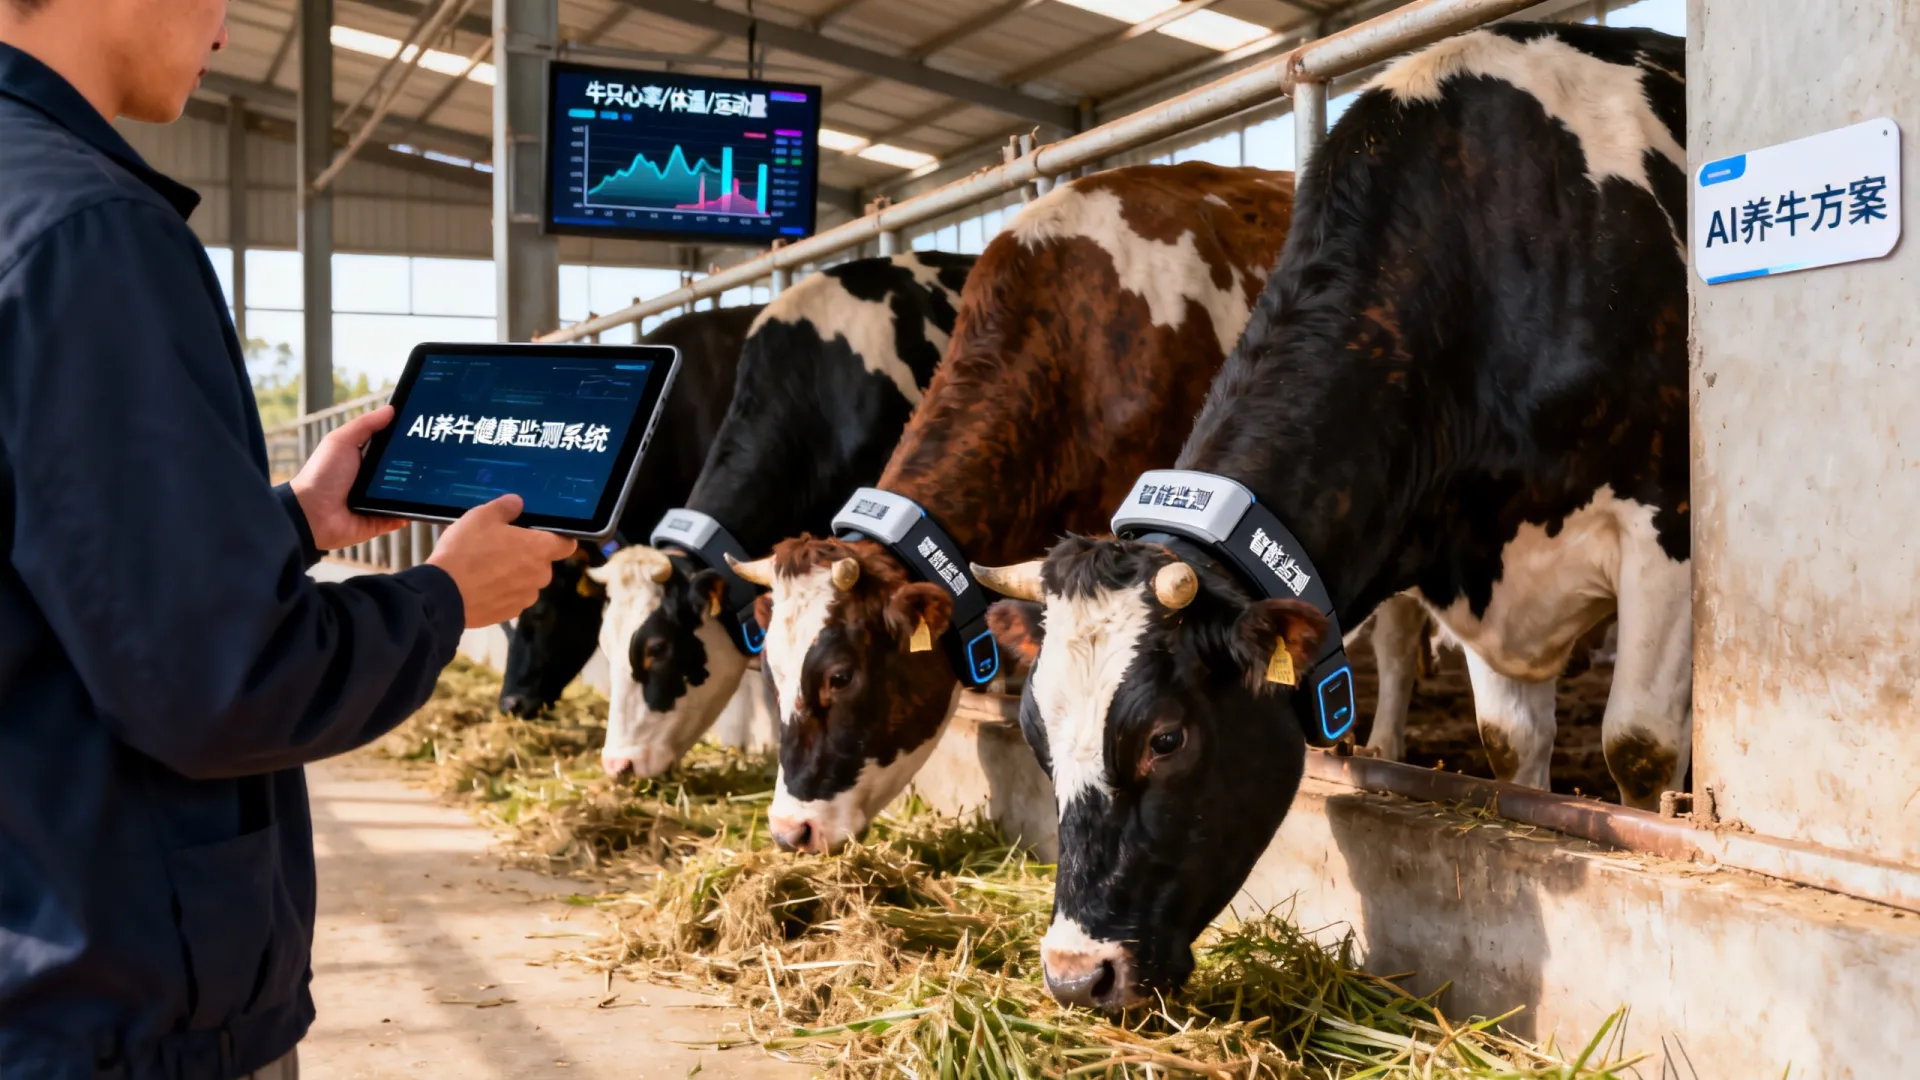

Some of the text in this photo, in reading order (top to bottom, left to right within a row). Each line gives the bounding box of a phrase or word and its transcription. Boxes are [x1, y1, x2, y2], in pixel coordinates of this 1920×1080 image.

[1706, 175, 1888, 248] AI养牛方案
[407, 413, 611, 453] AI养牛健康监测系统
